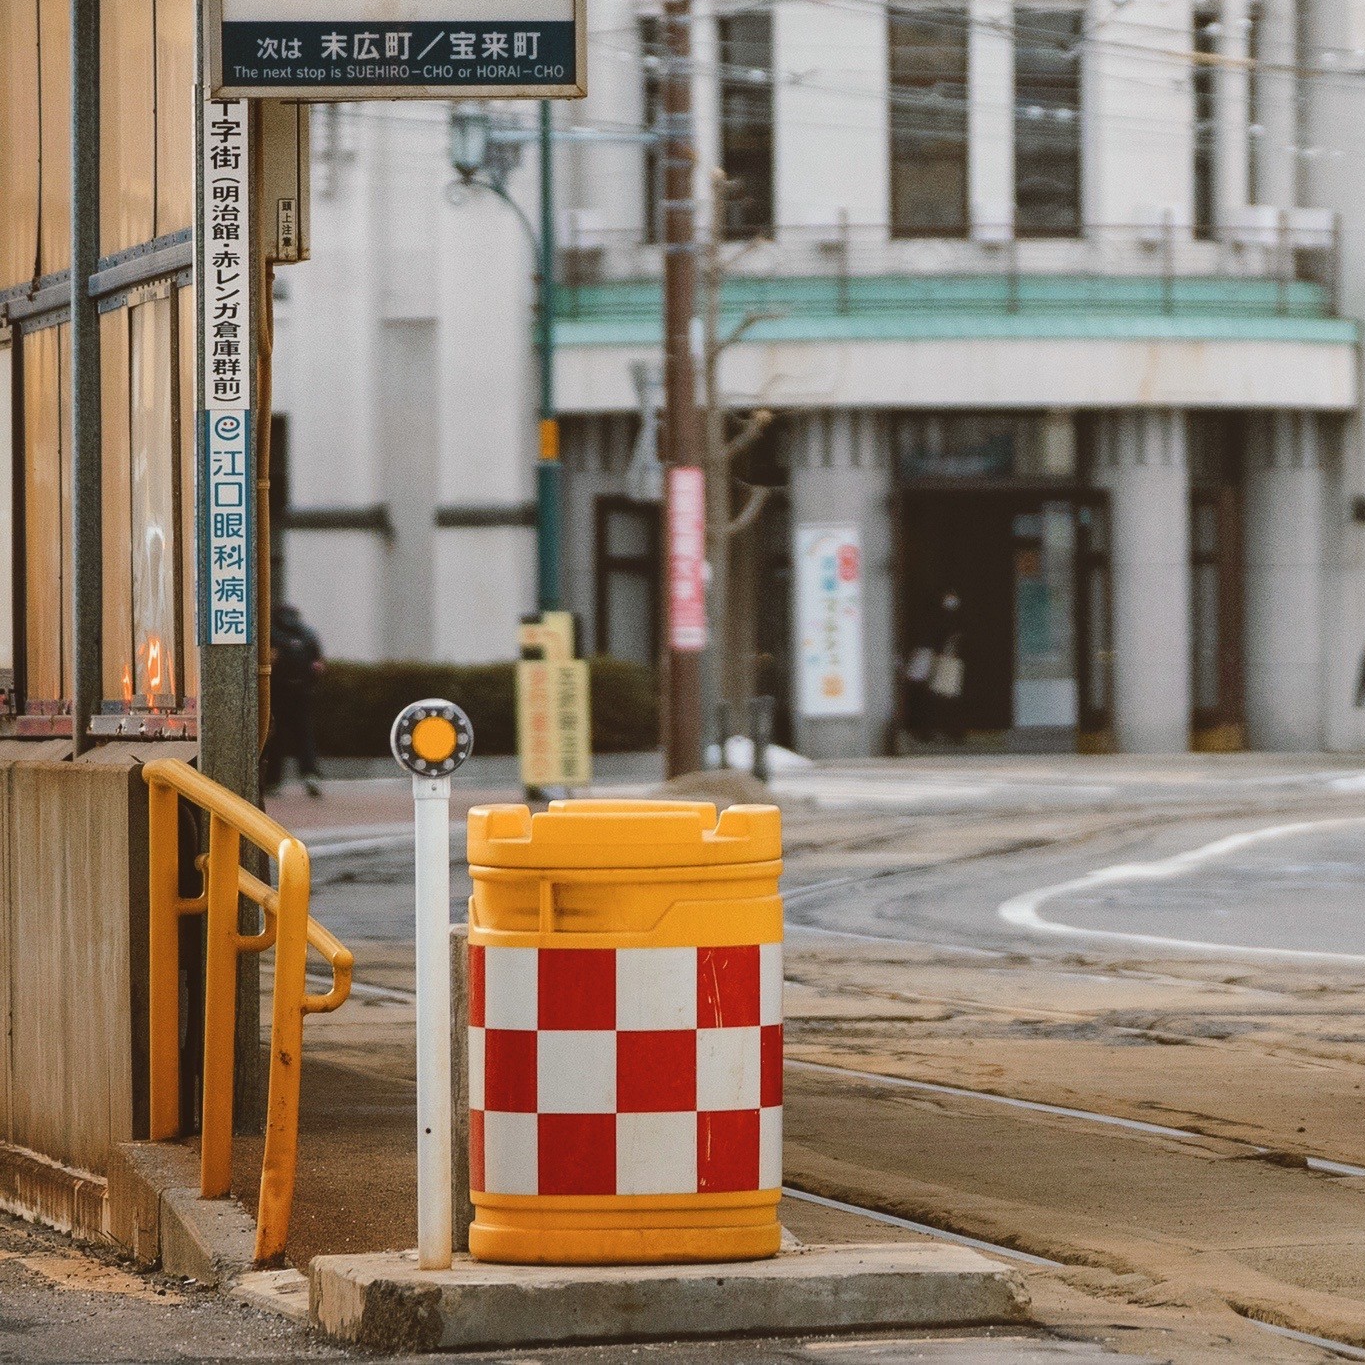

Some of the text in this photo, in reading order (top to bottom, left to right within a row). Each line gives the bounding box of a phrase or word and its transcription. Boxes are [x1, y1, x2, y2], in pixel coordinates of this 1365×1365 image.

[256, 37, 302, 60] 次は
[233, 66, 259, 79] The
[263, 67, 292, 79] next
[296, 67, 326, 81] stop
[330, 66, 342, 79] is
[458, 67, 473, 79] or
[212, 449, 245, 636] 江口眼科病院
